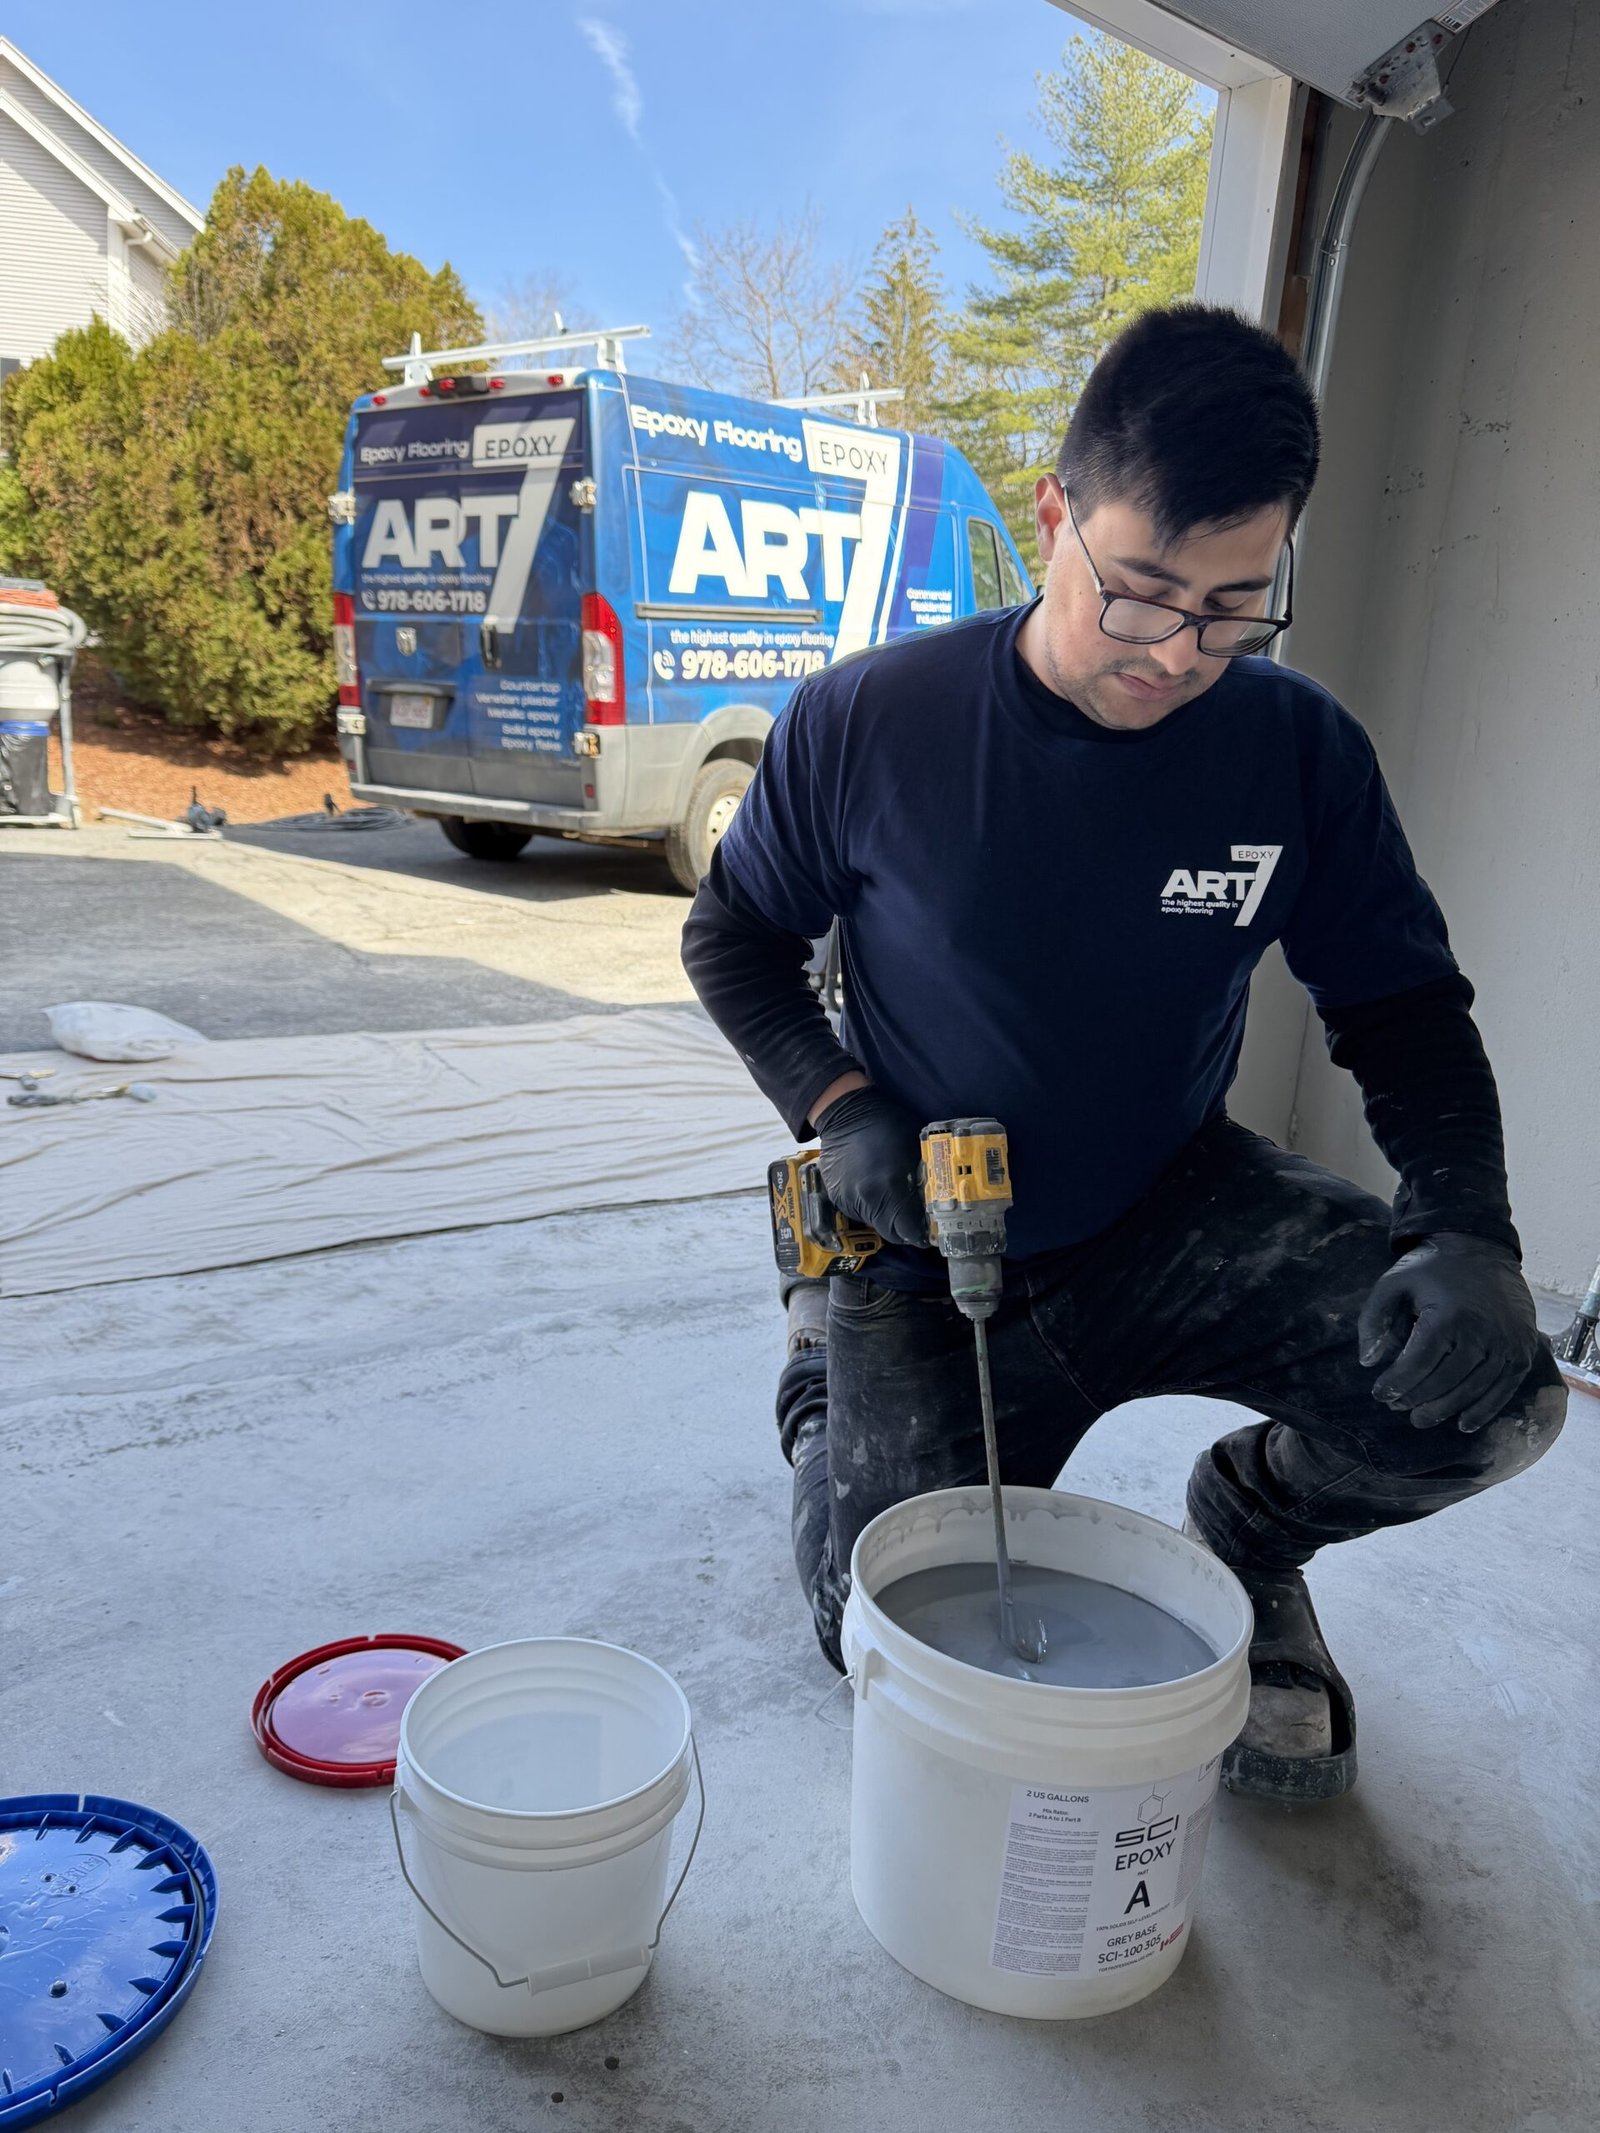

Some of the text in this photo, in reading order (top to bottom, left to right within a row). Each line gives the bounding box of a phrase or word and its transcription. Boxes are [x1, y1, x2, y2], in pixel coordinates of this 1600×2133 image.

[630, 405, 803, 463] Epoxy Flooring
[360, 438, 470, 464] Epoxy Flooring
[485, 435, 556, 459] EPOXY
[820, 440, 888, 474] EPOXY
[377, 589, 486, 612] 978-606-1718
[670, 629, 835, 648] the highest quality in epoxy flooring
[681, 649, 826, 680] 978-606-1718
[1238, 850, 1274, 859] EPOXY
[1161, 906, 1214, 916] epoxy flooring
[1176, 899, 1205, 908] highest
[1206, 900, 1231, 909] quality
[1033, 1791, 1046, 1799] US
[1047, 1793, 1090, 1803] GALLONS
[1114, 1814, 1180, 1848] SCI
[1115, 1838, 1176, 1871] EPOXY
[1124, 1880, 1150, 1915] A
[1106, 1933, 1134, 1947] GREY
[1134, 1923, 1158, 1940] BASE
[1097, 1943, 1143, 1964] SCI-100
[1144, 1933, 1162, 1950] 305
